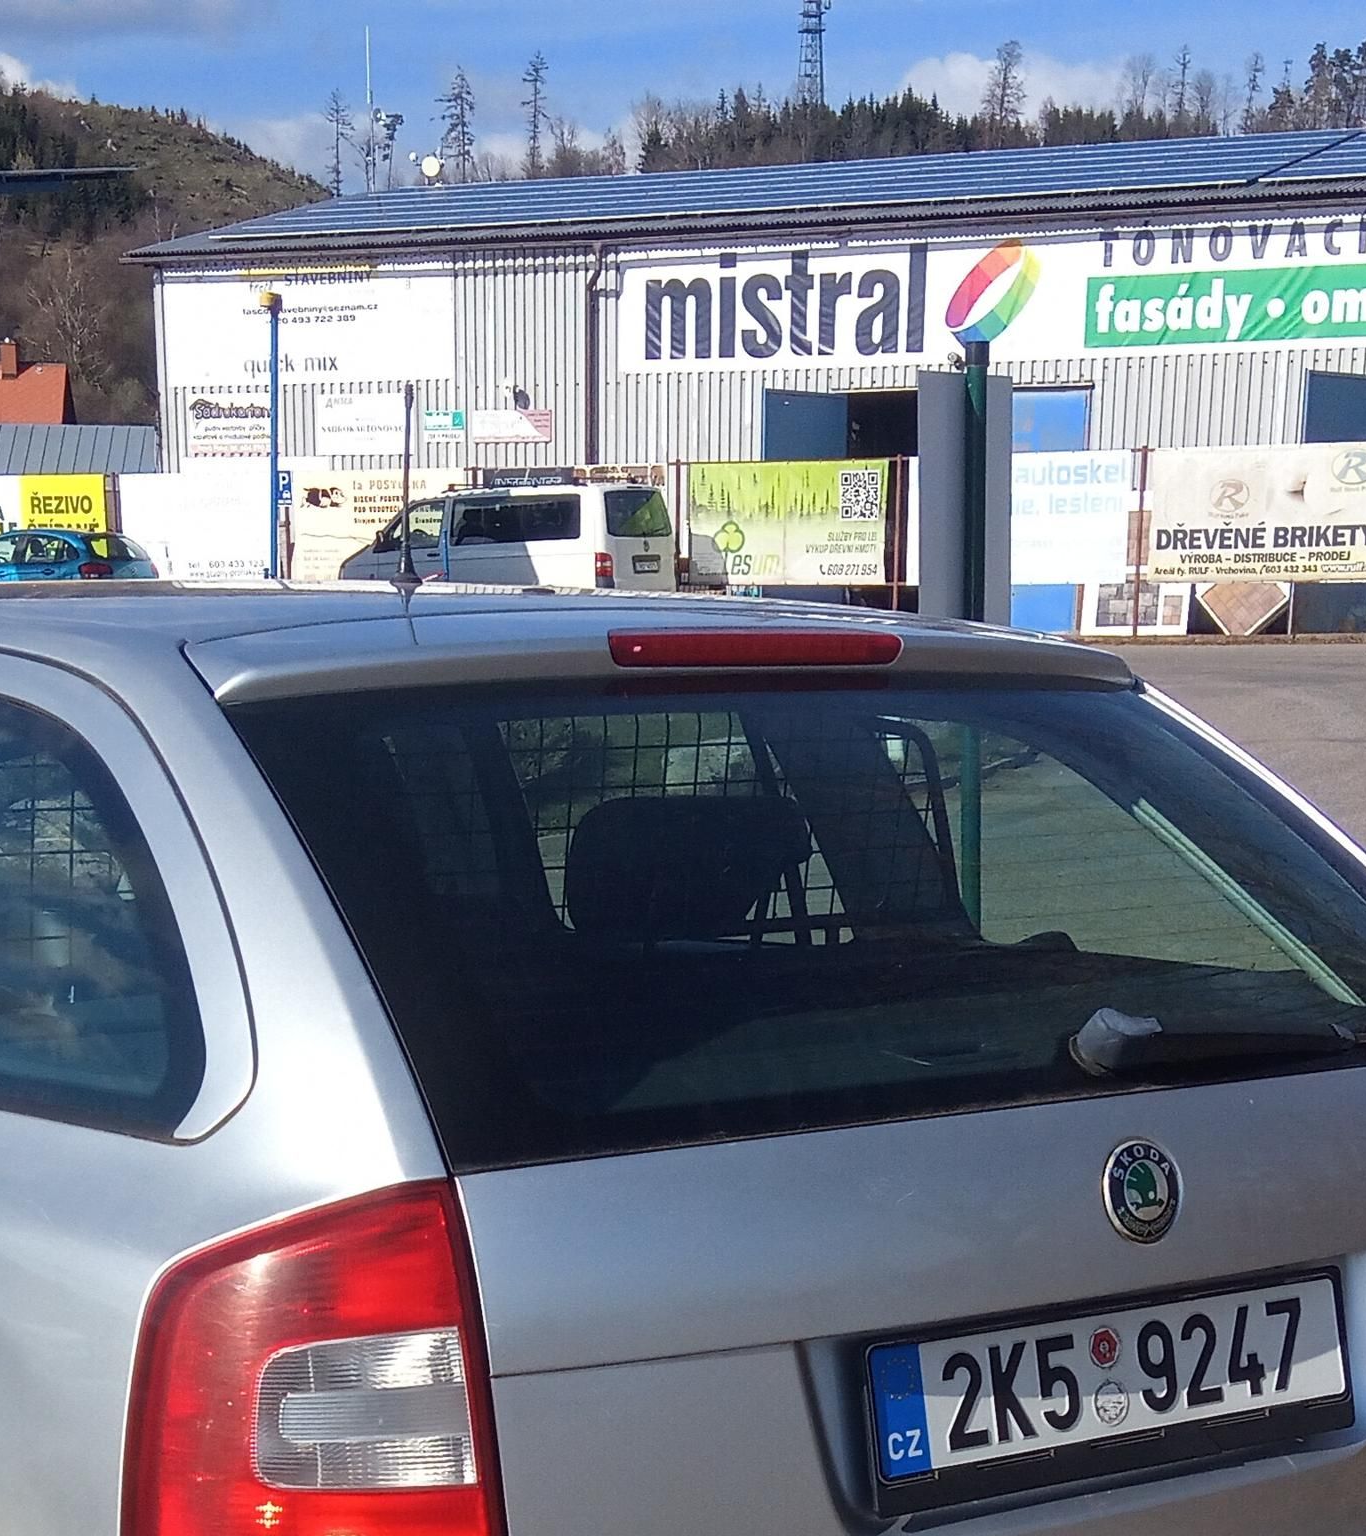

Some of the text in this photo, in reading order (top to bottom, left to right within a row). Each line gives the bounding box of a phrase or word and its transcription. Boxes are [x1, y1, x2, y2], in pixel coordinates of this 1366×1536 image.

[645, 243, 928, 361] mistral
[1095, 275, 1252, 342] fasády
[244, 353, 295, 379] quk
[279, 473, 289, 491] P
[30, 492, 93, 514] ŘEZIVO
[1156, 521, 1267, 550] DŘEVĚNÉ
[1180, 551, 1351, 564] VÝROBA DISTRIBUCE PRODEJ
[1188, 566, 1209, 575] RULF
[1265, 565, 1281, 574] 603
[1283, 565, 1299, 573] 432
[941, 1297, 1302, 1453] 2K5 9247
[887, 1428, 924, 1461] CZ
